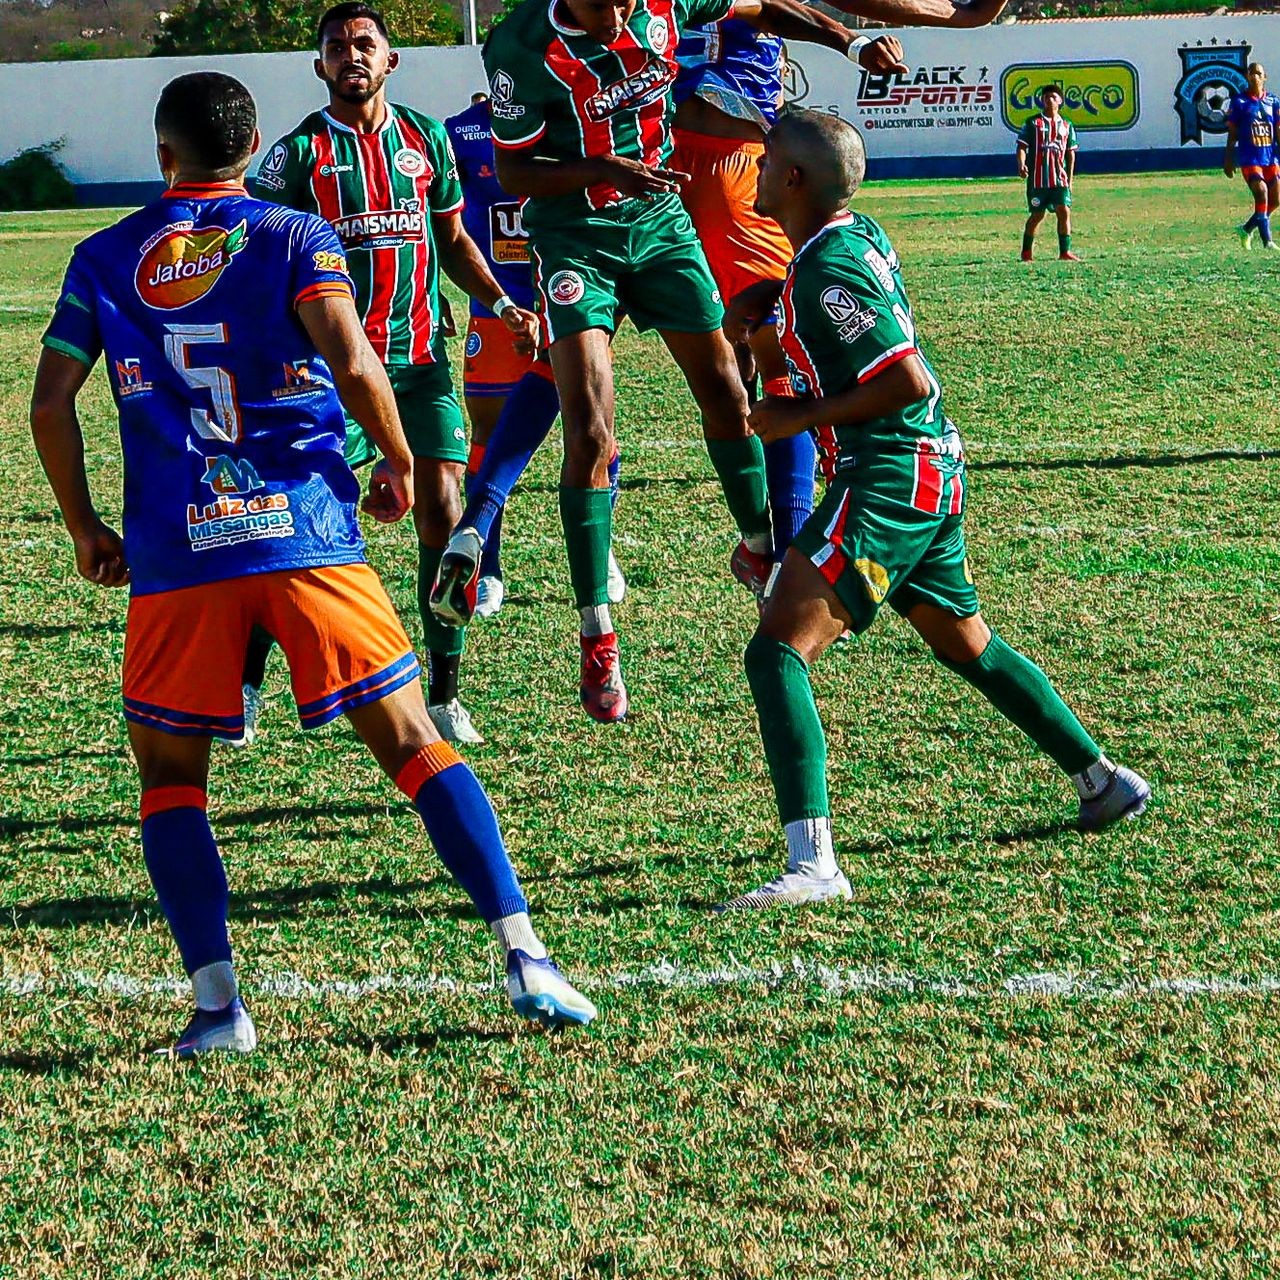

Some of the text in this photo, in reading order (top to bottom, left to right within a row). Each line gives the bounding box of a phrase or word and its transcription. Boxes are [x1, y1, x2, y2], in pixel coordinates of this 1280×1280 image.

[888, 86, 993, 106] SPORTS
[924, 105, 994, 113] ESPORTIVOS
[455, 125, 480, 134] OURO
[463, 131, 492, 141] VERDE
[335, 213, 422, 238] MAISMAIS
[149, 247, 223, 286] Jatobá
[163, 322, 242, 443] 5
[188, 494, 288, 524] Luiz das
[231, 534, 248, 544] para
[250, 528, 292, 539] Construção
